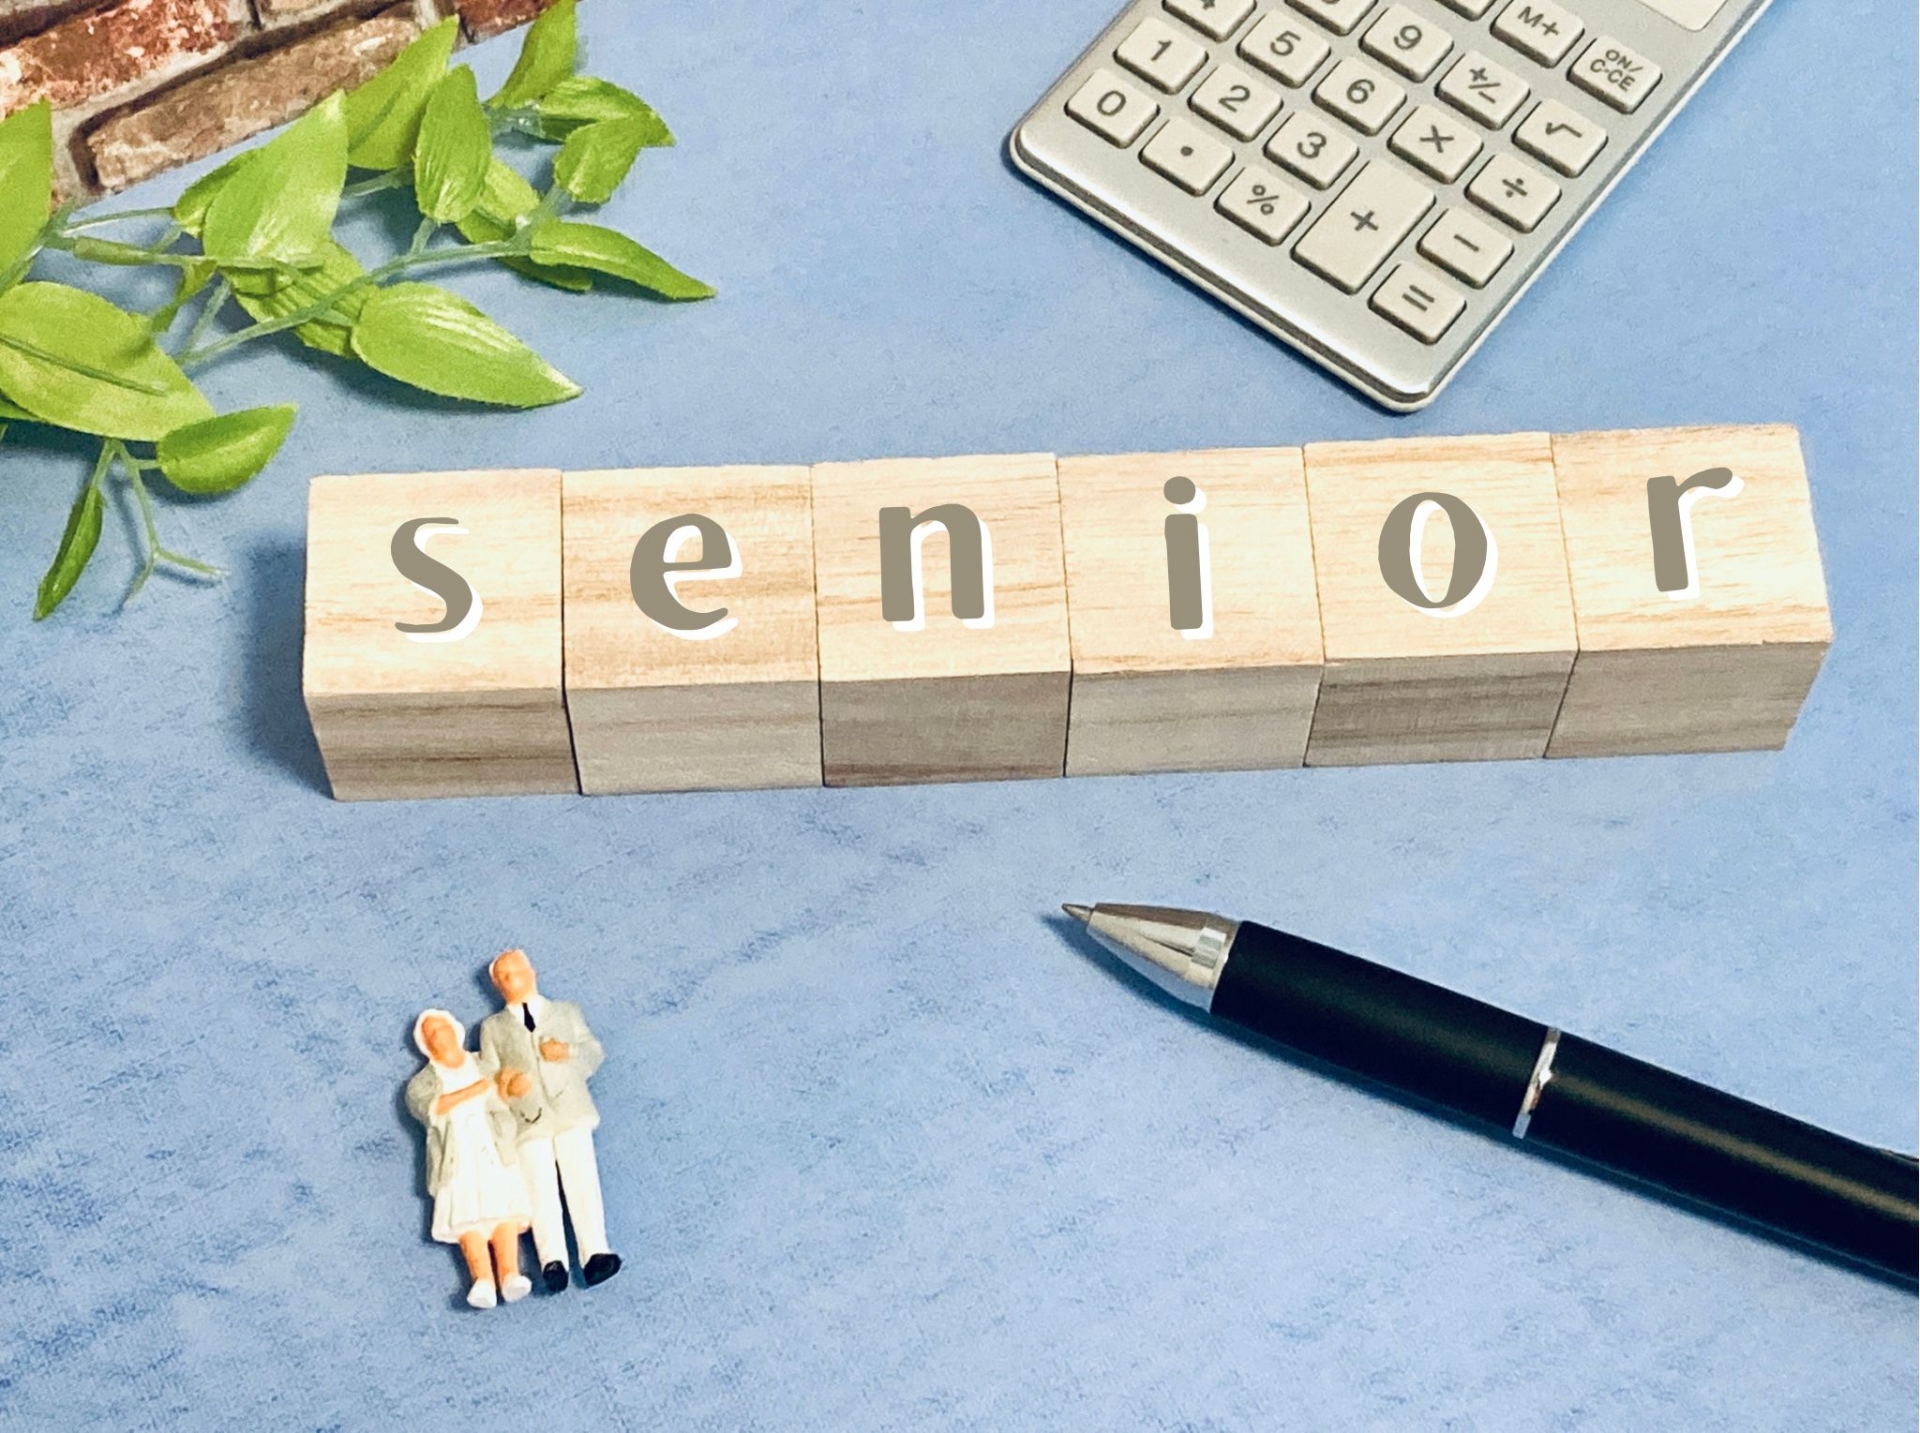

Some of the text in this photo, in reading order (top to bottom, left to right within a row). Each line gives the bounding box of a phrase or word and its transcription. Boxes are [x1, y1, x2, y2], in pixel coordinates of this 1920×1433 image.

[1517, 6, 1560, 36] M+
[1150, 39, 1173, 62] 1
[1269, 29, 1301, 57] 5
[1393, 24, 1423, 51] 9
[1605, 48, 1644, 74] ON/
[1096, 89, 1128, 117] 0
[1217, 84, 1251, 113] 2
[1345, 78, 1376, 105] 6
[1296, 131, 1328, 160] 3
[1246, 183, 1280, 216] %
